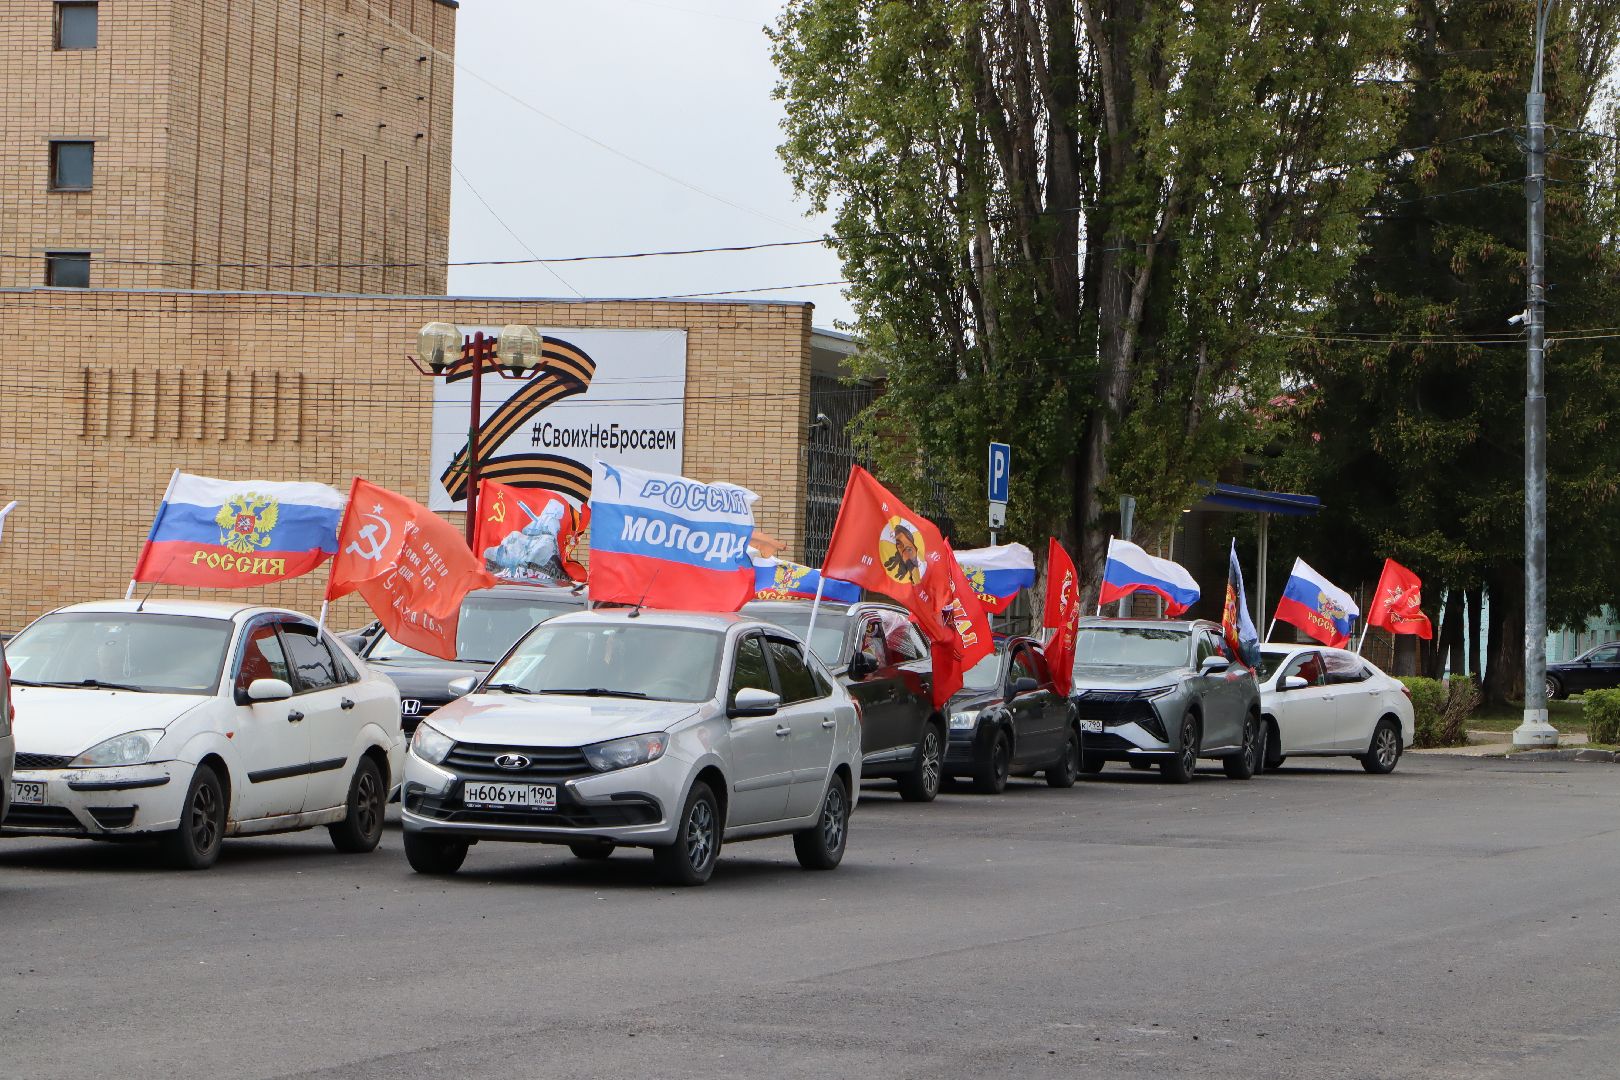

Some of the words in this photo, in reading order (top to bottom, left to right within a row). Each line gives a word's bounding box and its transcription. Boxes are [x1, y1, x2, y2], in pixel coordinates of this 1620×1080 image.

[532, 422, 676, 454] #СвоихНеБросаем
[994, 451, 1005, 494] P
[640, 479, 749, 515] РОССИЯ
[190, 550, 286, 576] РОССИЯ
[16, 783, 40, 797] 799
[530, 787, 553, 799] 190
